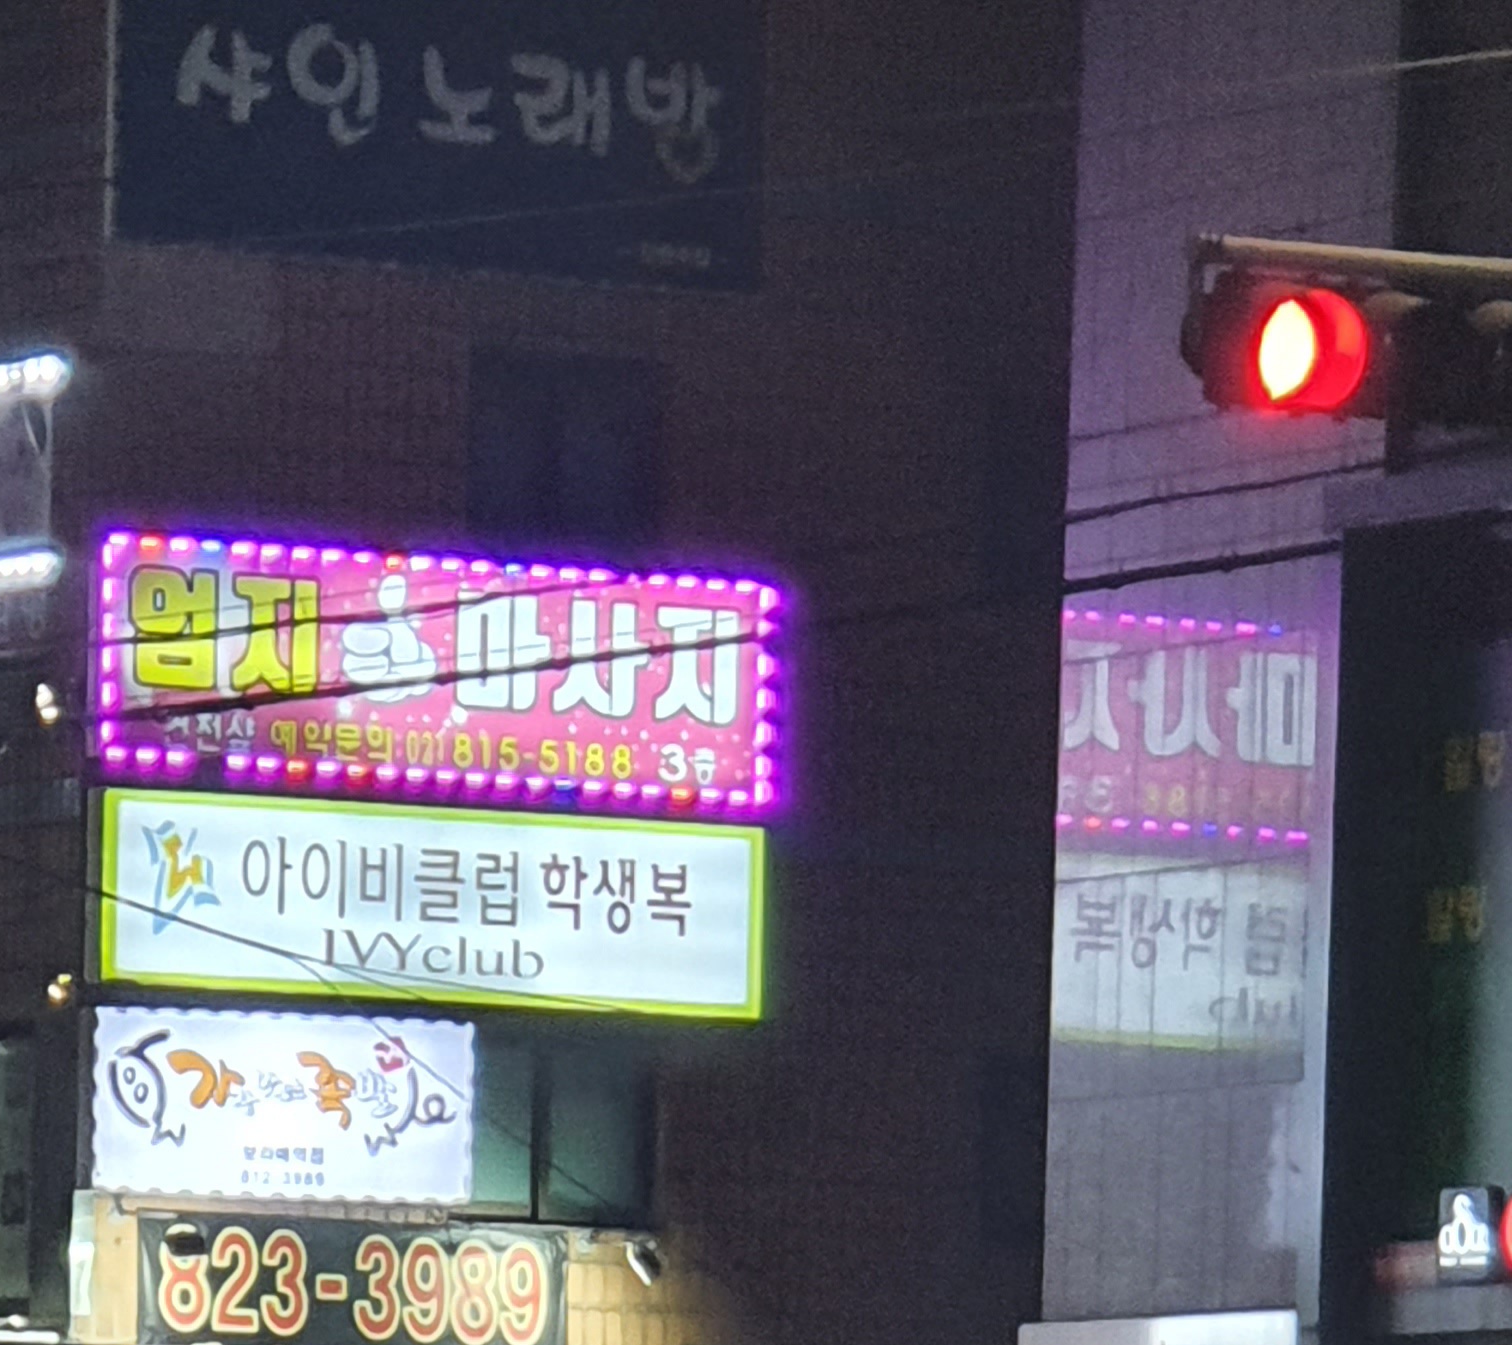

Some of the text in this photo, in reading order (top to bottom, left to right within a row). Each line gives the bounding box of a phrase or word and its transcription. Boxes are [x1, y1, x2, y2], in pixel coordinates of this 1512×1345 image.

[416, 47, 722, 186] 노래방
[129, 564, 740, 726] 엄지 마사지
[240, 834, 694, 938] 아이비클럽 학생복
[322, 928, 546, 980] IVYclub
